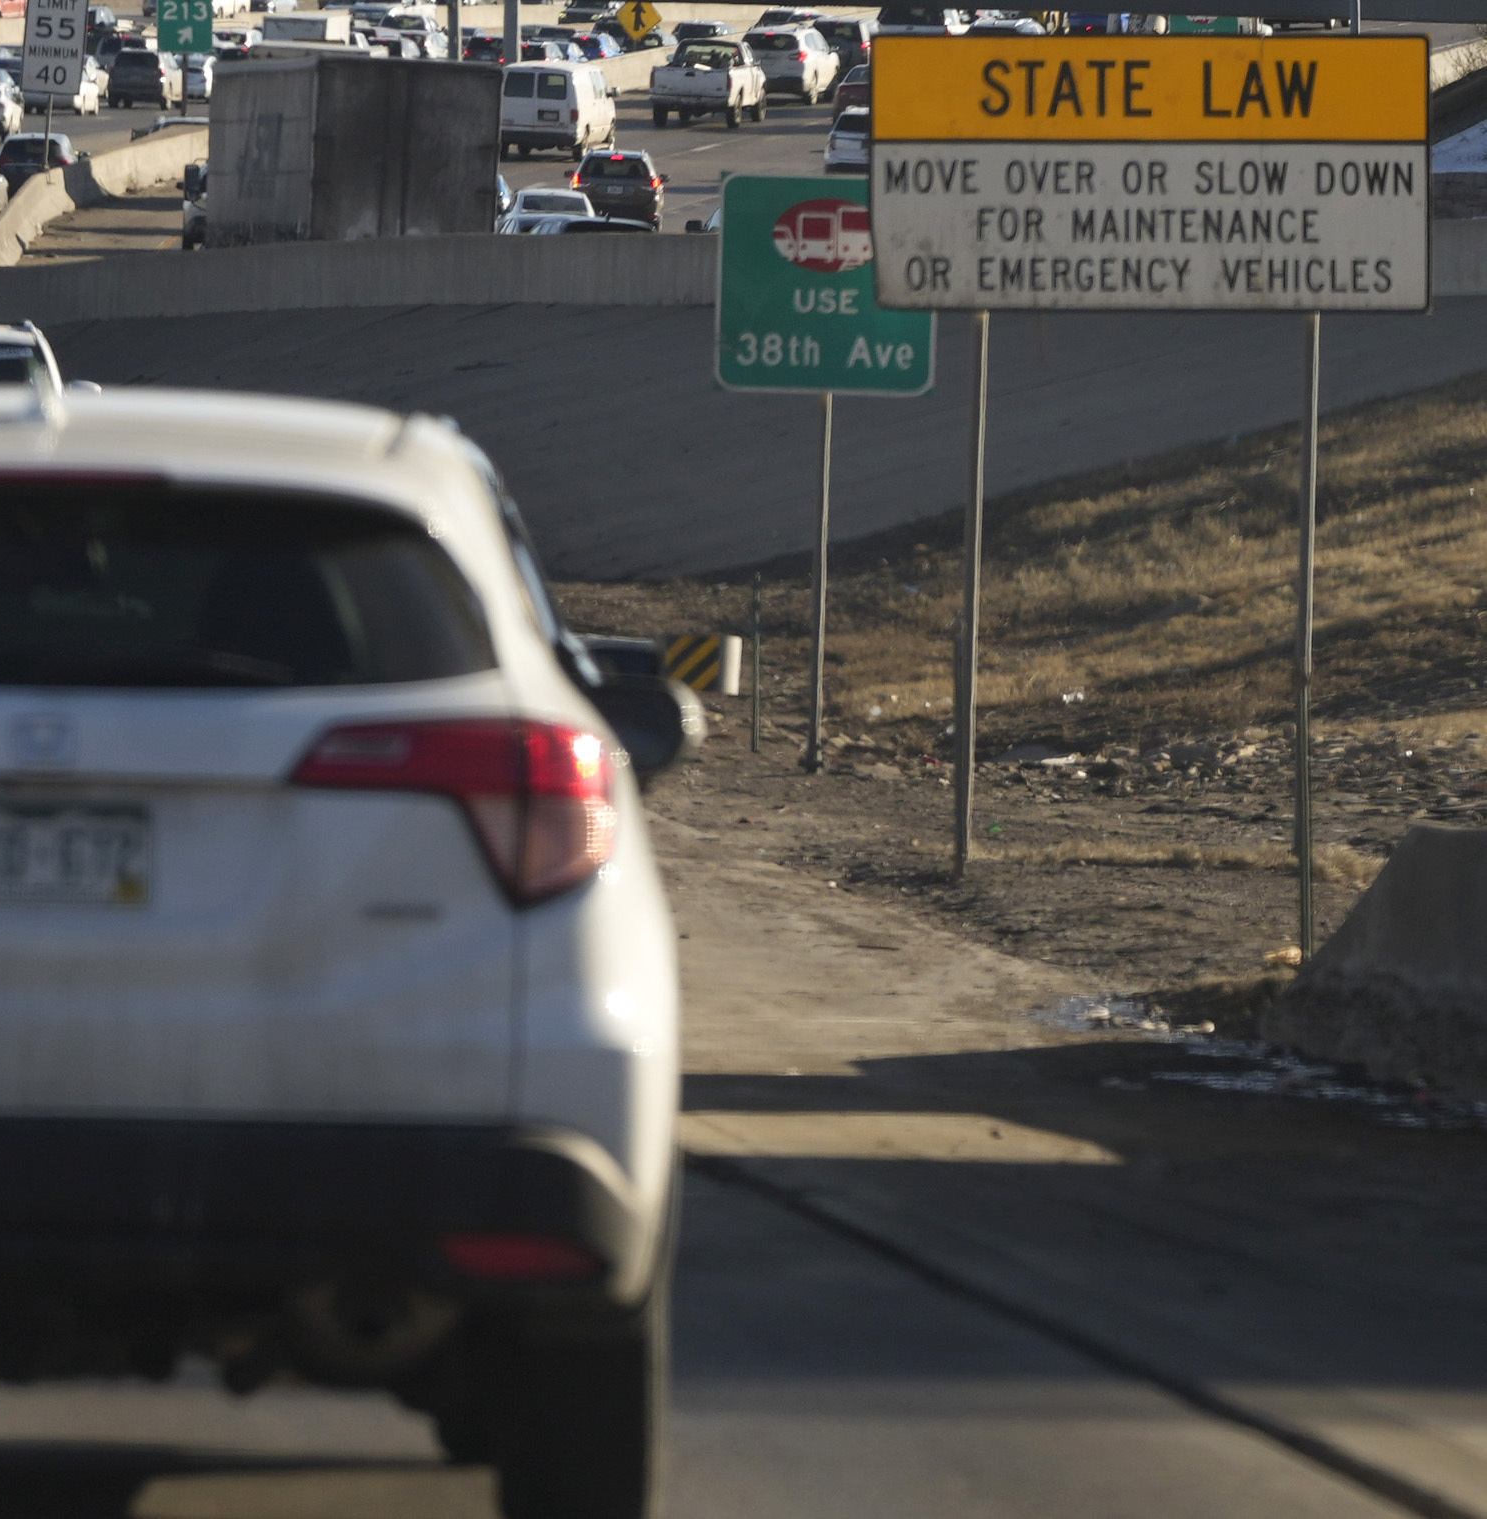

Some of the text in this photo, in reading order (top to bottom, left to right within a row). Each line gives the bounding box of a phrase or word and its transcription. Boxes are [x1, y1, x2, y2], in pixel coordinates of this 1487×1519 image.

[163, 1, 208, 21] 213
[36, 16, 75, 40] 55
[29, 46, 78, 58] MINIMUM
[36, 65, 66, 85] 40
[981, 60, 1317, 117] STATE LAW
[886, 160, 1412, 195] MOVE OVER OR SLOW DOWN
[977, 207, 1319, 243] FOR MAINTENANCE
[906, 255, 1391, 293] OR EMERGENCY VEHICLES
[794, 289, 858, 314] USE
[737, 333, 913, 369] 38th Ave
